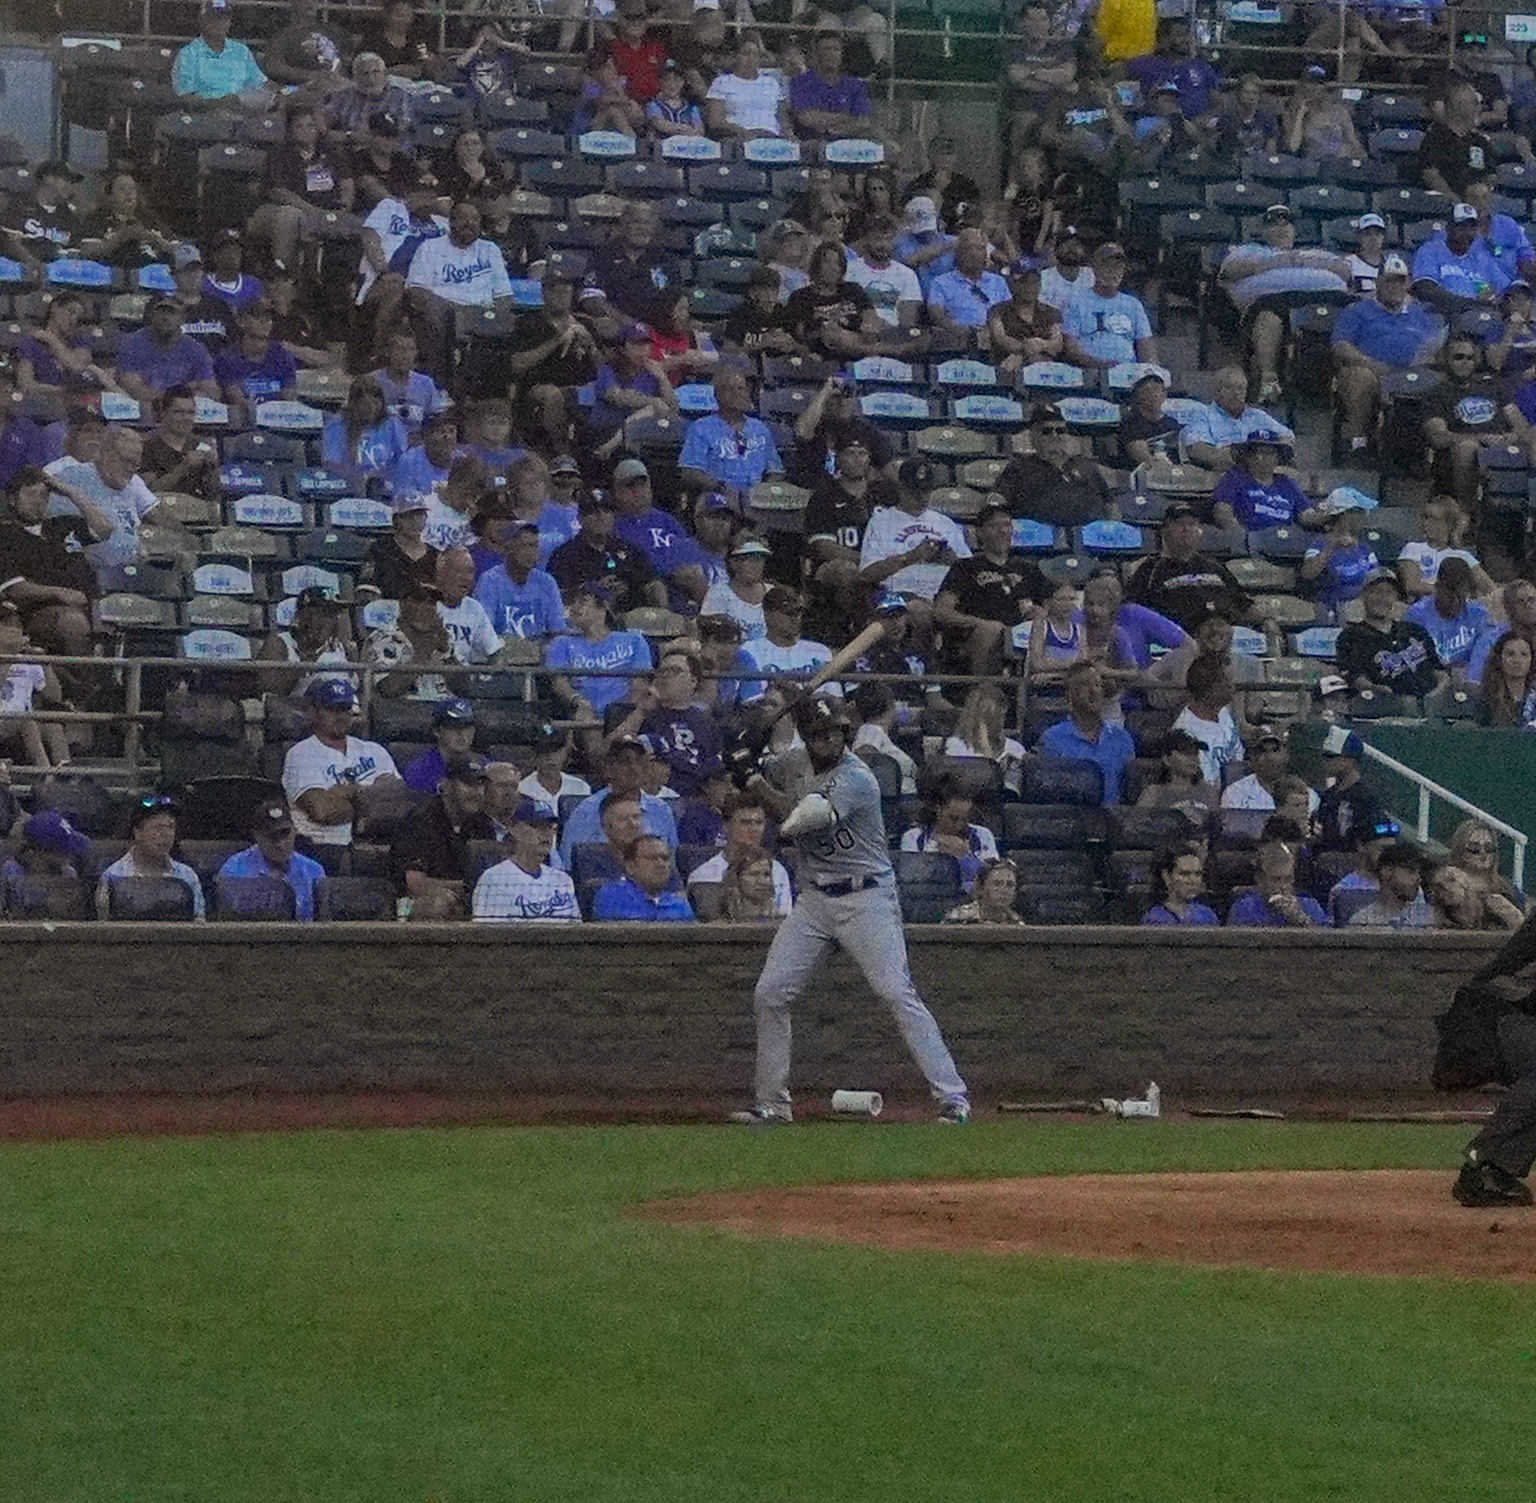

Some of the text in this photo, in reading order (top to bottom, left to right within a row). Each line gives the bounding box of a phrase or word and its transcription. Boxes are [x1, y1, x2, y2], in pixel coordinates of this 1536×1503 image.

[441, 258, 493, 285] Royals
[650, 527, 675, 548] KC
[504, 605, 535, 640] KC
[573, 643, 635, 671] Royals
[513, 889, 574, 918] Royals
